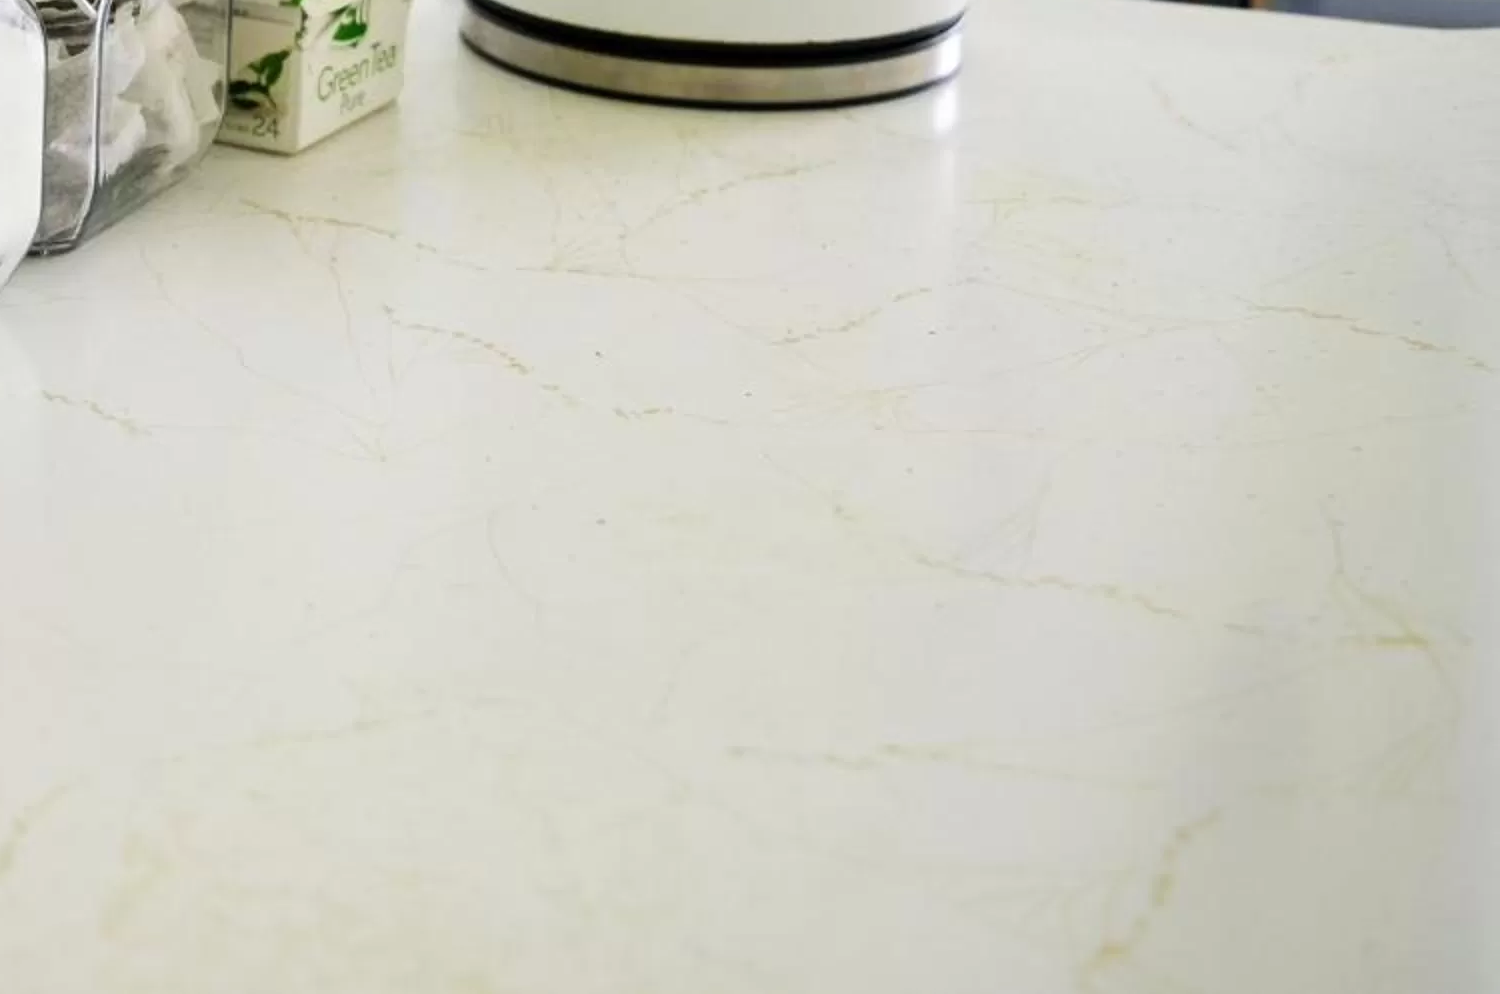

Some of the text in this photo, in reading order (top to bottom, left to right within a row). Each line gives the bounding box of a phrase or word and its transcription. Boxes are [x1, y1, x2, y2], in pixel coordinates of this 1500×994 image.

[317, 41, 398, 102] Green Tea
[251, 114, 281, 139] 24
